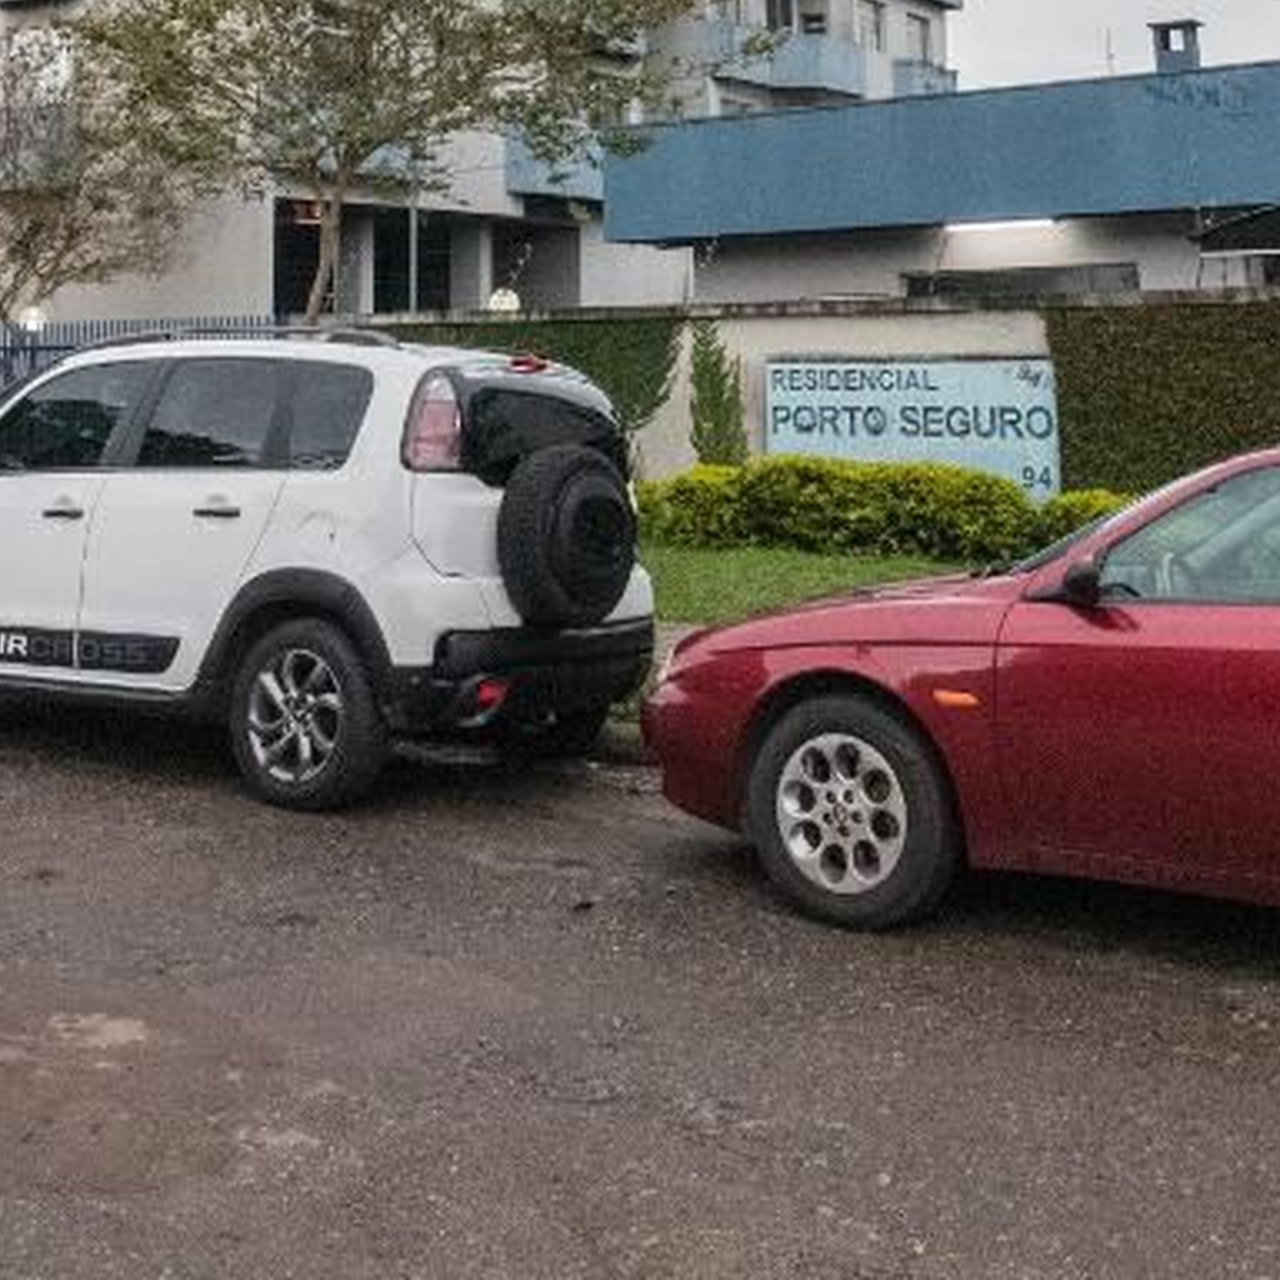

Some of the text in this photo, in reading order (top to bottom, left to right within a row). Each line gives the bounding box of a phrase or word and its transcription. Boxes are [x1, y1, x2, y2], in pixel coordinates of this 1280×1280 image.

[771, 369, 940, 391] RESIDENCIAL
[771, 405, 1054, 439] PORTO SEGURO
